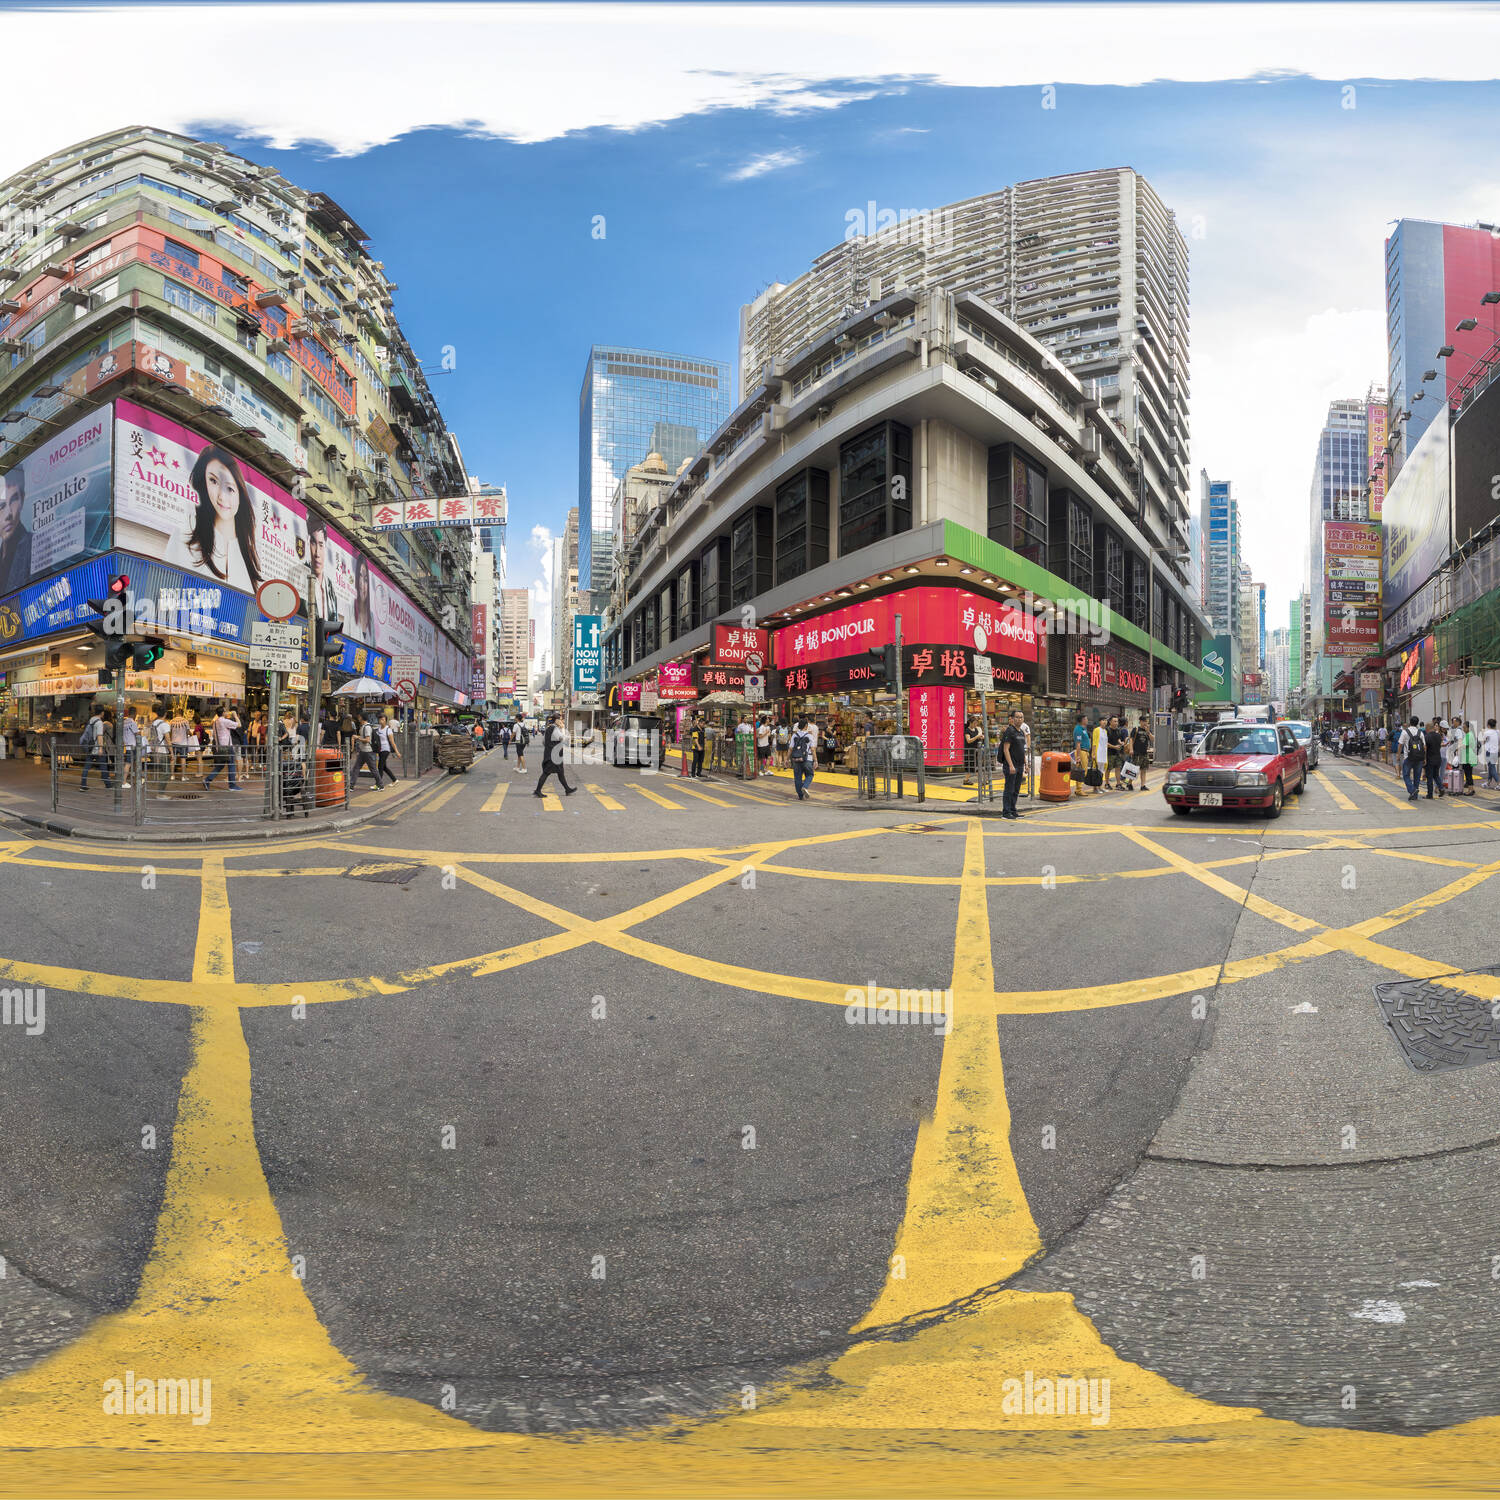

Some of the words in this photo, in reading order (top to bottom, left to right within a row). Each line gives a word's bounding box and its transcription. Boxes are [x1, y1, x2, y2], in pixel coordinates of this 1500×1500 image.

[49, 424, 102, 465] MODERN
[131, 431, 144, 460] 英文
[129, 461, 201, 505] Antonia
[32, 476, 88, 518] Frankie
[32, 513, 55, 532] Chan
[262, 525, 281, 549] Kris
[25, 576, 71, 627] HOLLYWOOD
[159, 587, 222, 611] HOLLYWOOD
[388, 597, 416, 633] MODERN
[289, 637, 299, 646] 10
[576, 623, 600, 648] i.t
[820, 617, 875, 645] BONJOUR
[993, 620, 1036, 646] BONJOUR
[1331, 626, 1364, 634] sincere
[289, 662, 300, 670] 10
[576, 649, 599, 658] NOW
[576, 658, 599, 666] OPEN
[991, 667, 1025, 683] BONJOUR
[1119, 668, 1148, 693] BONJOUR
